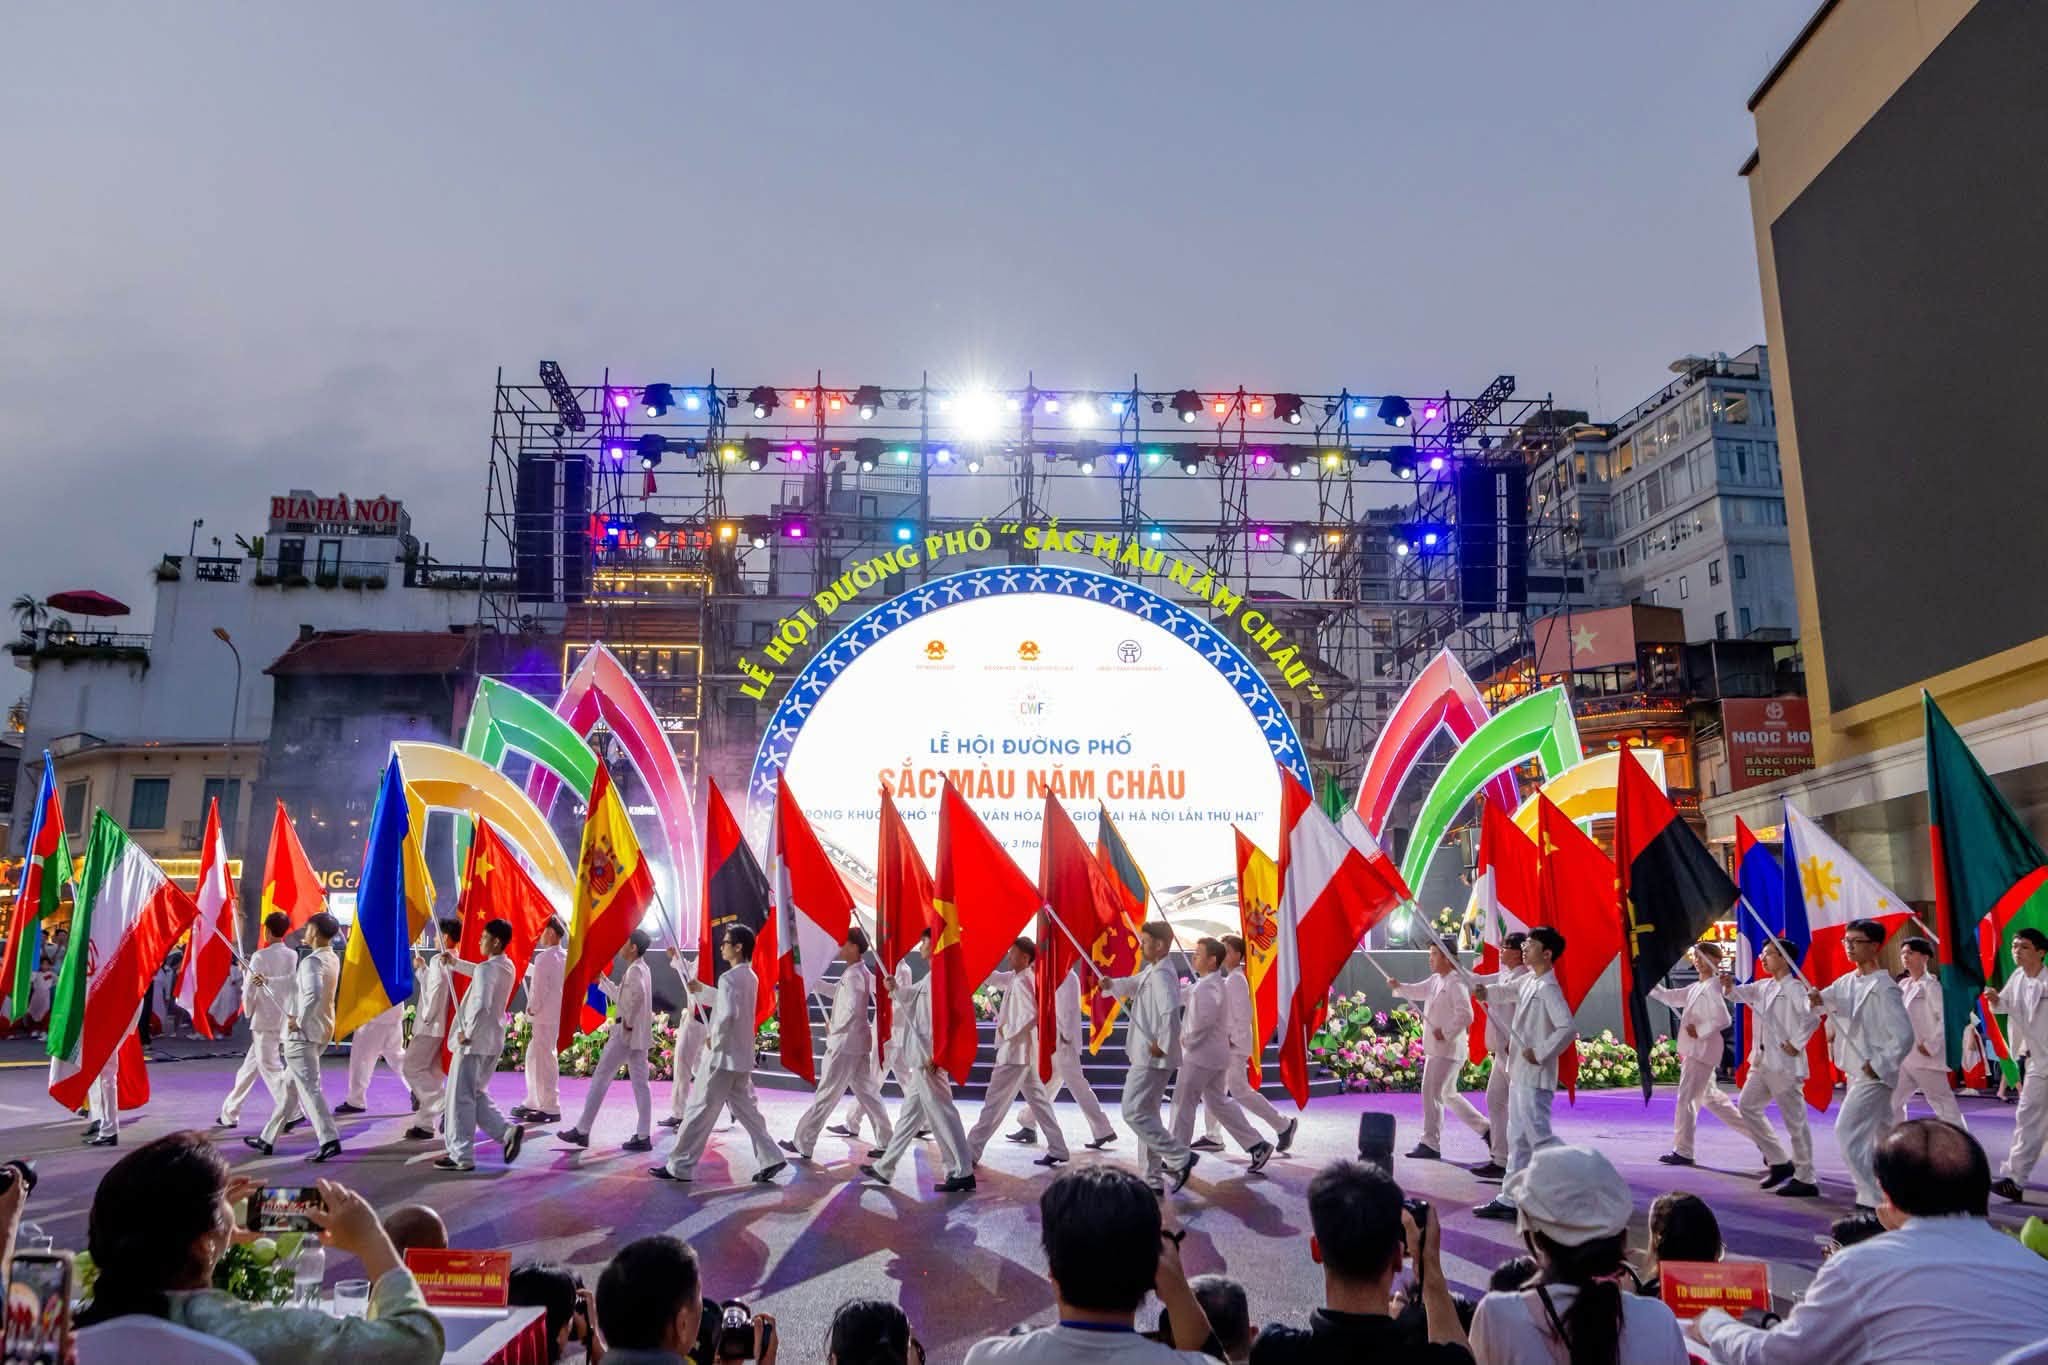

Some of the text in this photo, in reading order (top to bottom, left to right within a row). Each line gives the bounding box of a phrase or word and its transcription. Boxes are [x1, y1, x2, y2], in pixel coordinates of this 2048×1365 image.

[271, 492, 401, 528] BIA HÀ NỘI
[738, 657, 775, 701] LỄ
[763, 608, 818, 665] HỘI
[814, 544, 920, 616] ĐƯỜNG
[925, 517, 992, 561] PHỐ
[1092, 534, 1166, 575] MÀU
[1168, 559, 1244, 616] NĂM
[1020, 702, 1046, 715] CWF
[930, 731, 1132, 759] LỄ HỘI ĐƯỜNG PHỐ
[1786, 731, 1810, 743] HO
[878, 756, 1186, 801] SẮC MÀU NĂM CHÂU
[805, 809, 843, 821] RONG
[848, 808, 880, 820] KHUÔ
[313, 871, 344, 889] NG
